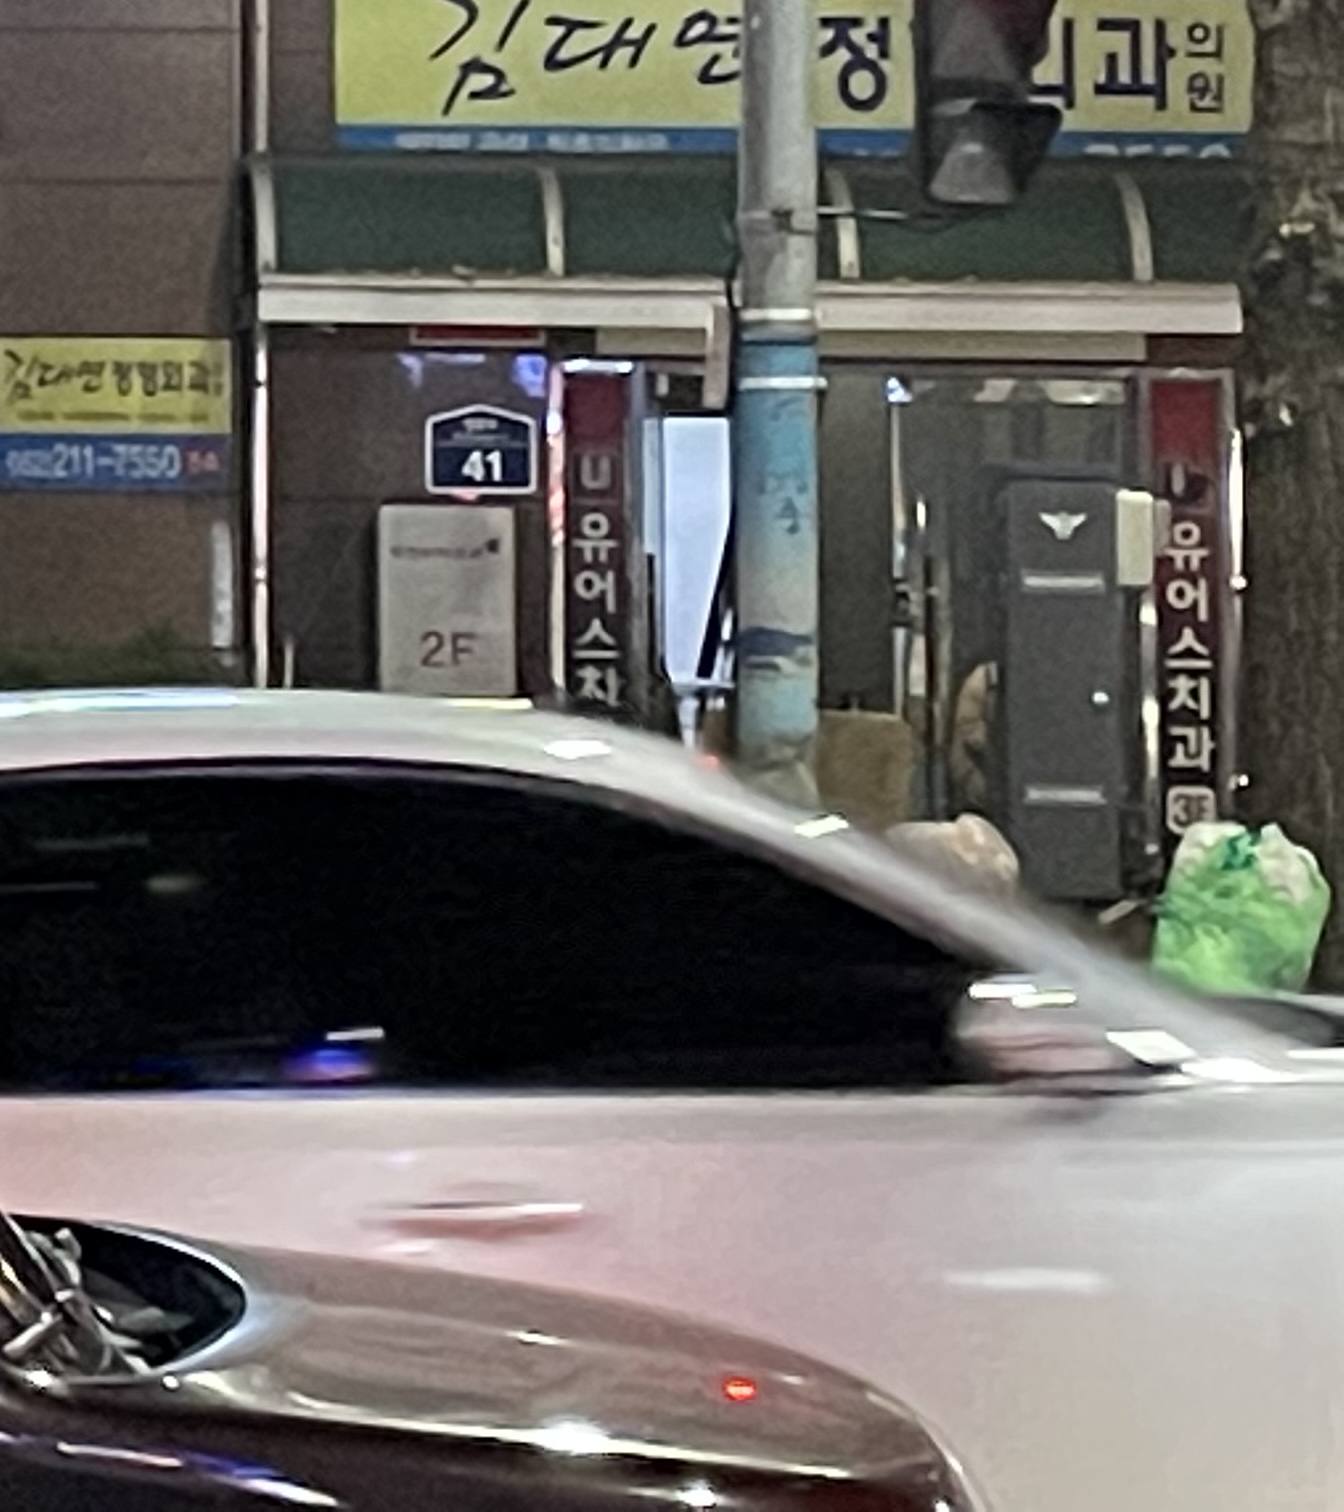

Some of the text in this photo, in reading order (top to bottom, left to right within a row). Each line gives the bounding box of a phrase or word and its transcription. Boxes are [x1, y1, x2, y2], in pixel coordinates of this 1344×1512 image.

[461, 450, 503, 482] 41
[420, 630, 478, 668] 2F
[1164, 521, 1216, 773] 유어스치과
